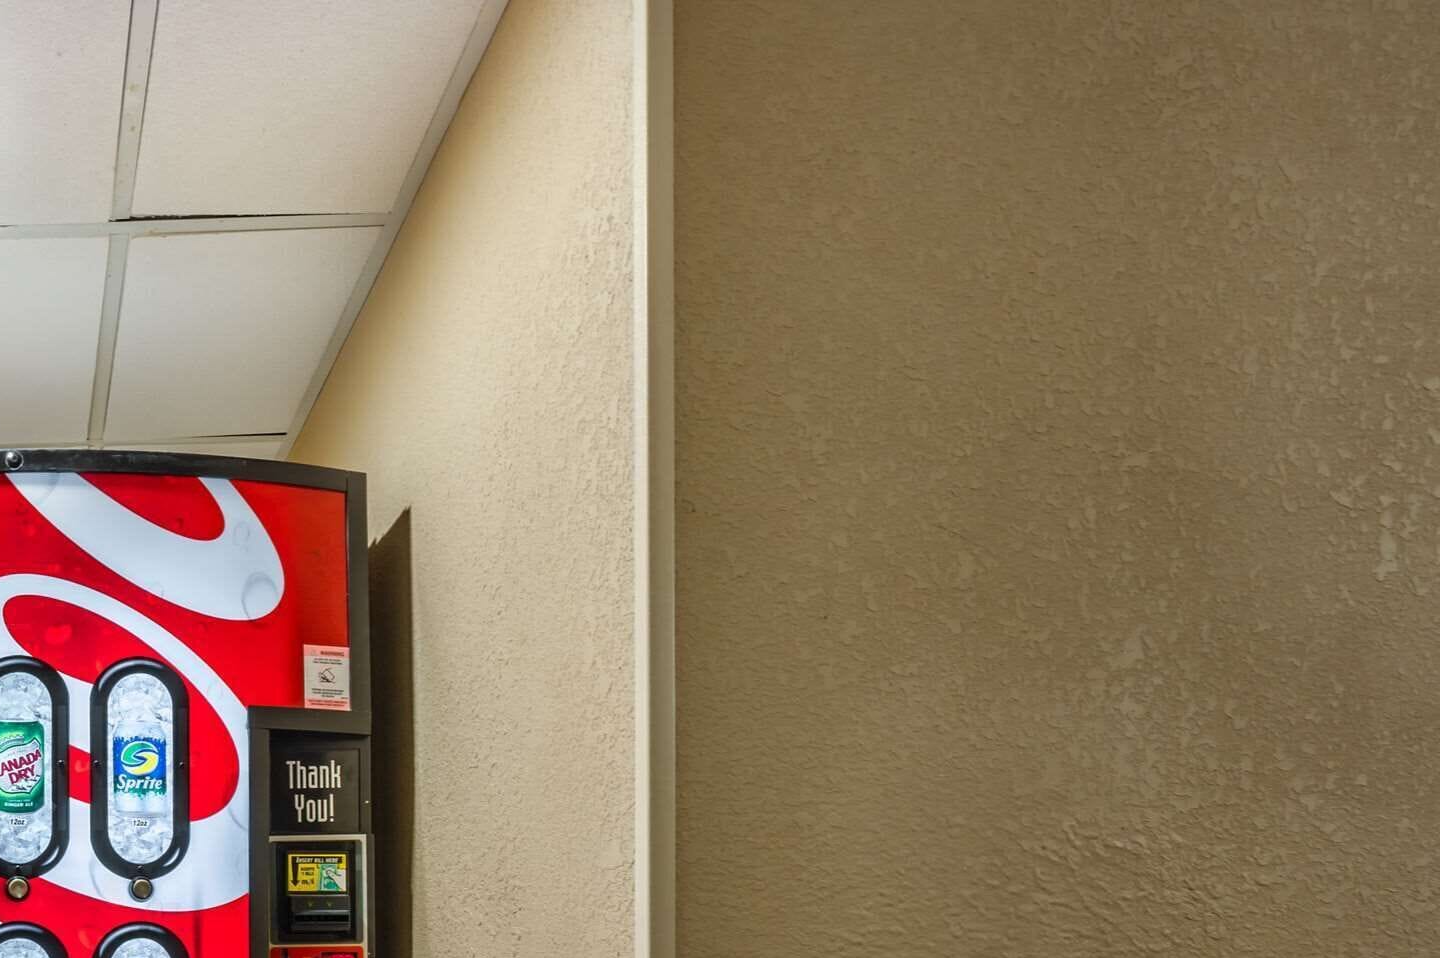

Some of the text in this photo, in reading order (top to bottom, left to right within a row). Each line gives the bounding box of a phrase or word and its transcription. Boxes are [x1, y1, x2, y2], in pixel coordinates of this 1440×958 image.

[8, 764, 36, 785] DRY
[116, 774, 163, 793] Sprite
[285, 759, 342, 790] Thank
[294, 793, 335, 823] You!
